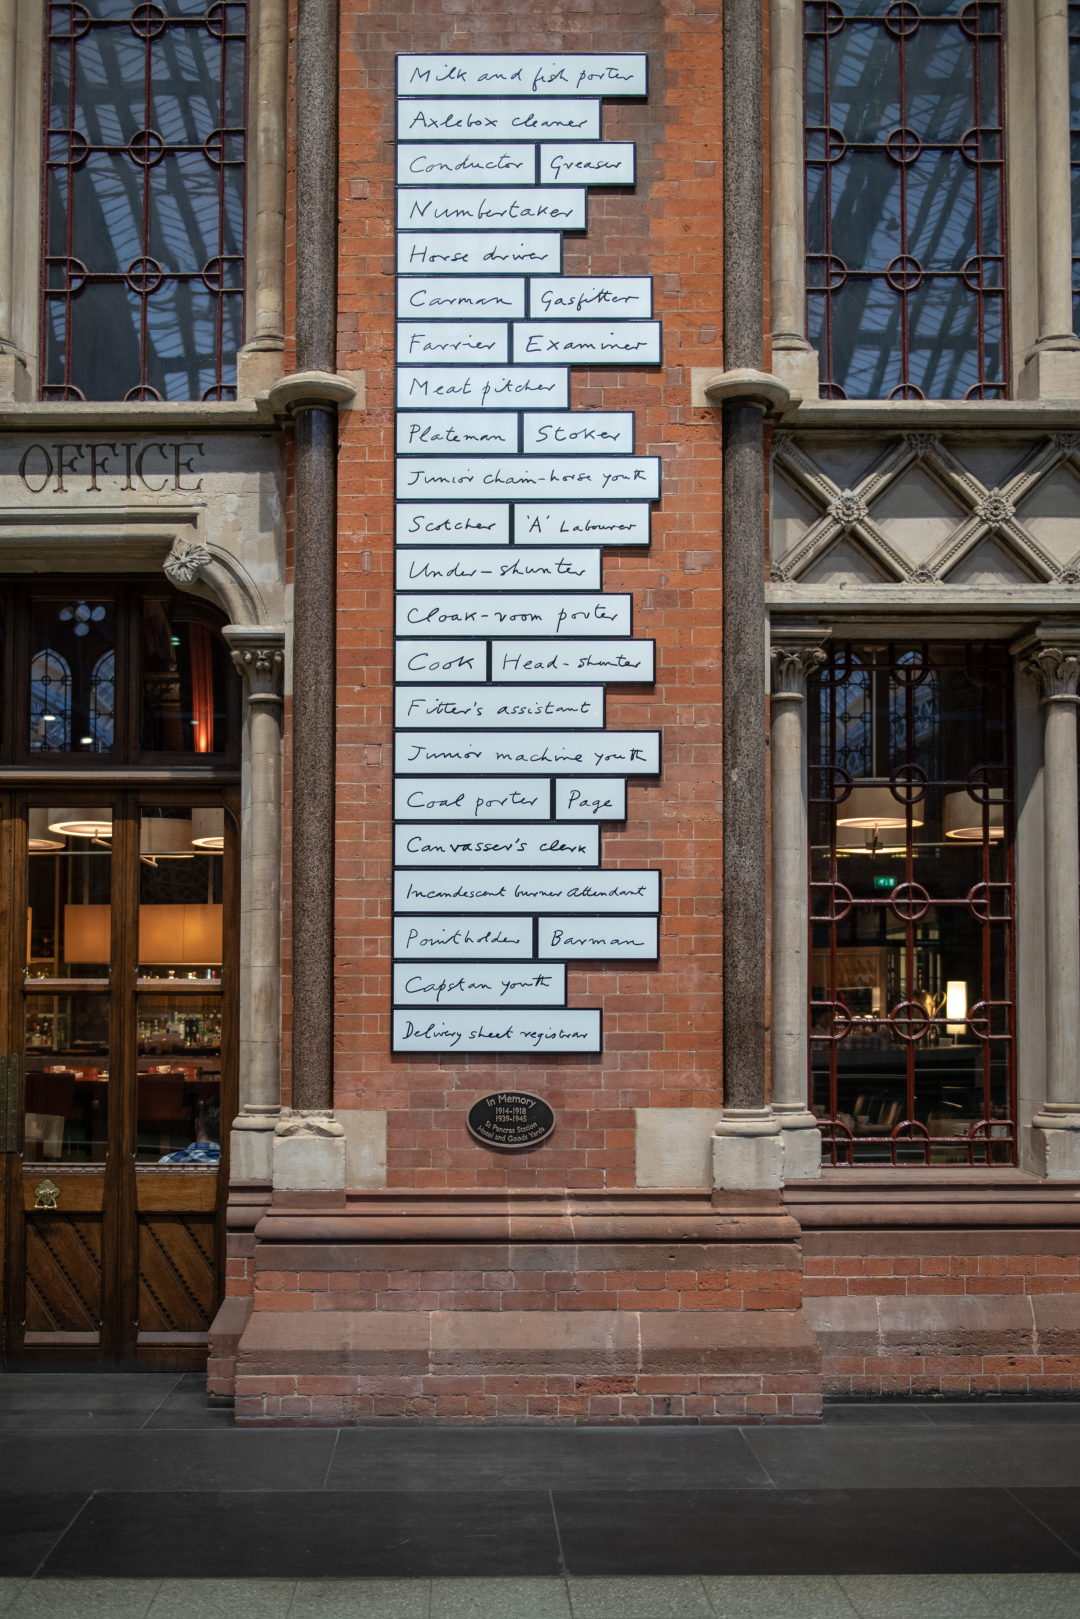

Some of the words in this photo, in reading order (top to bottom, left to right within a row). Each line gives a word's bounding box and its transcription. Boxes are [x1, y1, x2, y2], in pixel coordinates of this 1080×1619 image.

[410, 65, 467, 83] Milk
[477, 68, 522, 81] and
[532, 62, 568, 92] fish
[576, 68, 634, 88] porter
[409, 111, 498, 128] Axlebox
[512, 114, 587, 128] cleaner
[410, 154, 523, 173] Conductor
[410, 199, 573, 219] Numbertaker
[410, 245, 468, 263] Horse
[483, 243, 548, 260] driver
[410, 290, 512, 306] Carman
[541, 288, 639, 312] Gasfitter
[410, 334, 495, 353] Farrier
[526, 333, 647, 352] Examiner
[410, 378, 471, 395] Meat
[481, 377, 555, 405] pitcher
[409, 424, 505, 443] Plateman
[536, 425, 620, 442] Stoker
[18, 442, 205, 493] OFFICE
[408, 469, 474, 485] Junior
[602, 469, 646, 488] youth
[409, 516, 496, 532] Scotcher
[560, 520, 636, 532] Labourer
[407, 608, 542, 623] Cloak-room
[557, 604, 618, 632] porter
[408, 653, 474, 670] Cook
[408, 699, 483, 716] Fitter's
[497, 701, 590, 714] assistant
[408, 744, 482, 761] Junior
[496, 747, 582, 762] machine
[594, 748, 646, 766] youth
[407, 792, 465, 808] Coal
[475, 791, 538, 816] porter
[568, 790, 612, 814] Page
[407, 836, 527, 852] Canvasser's
[540, 840, 586, 853] clerk
[407, 884, 506, 899] Incandescent
[515, 885, 562, 897] burner
[567, 886, 646, 897] attendant
[407, 929, 520, 948] Pointholder
[551, 930, 644, 946] Barman
[405, 976, 491, 1002] Capstan
[500, 974, 552, 996] youth
[402, 1021, 461, 1047] Delivery
[469, 1026, 513, 1039] sheet
[520, 1028, 587, 1046] registrar
[486, 1098, 496, 1107] In
[498, 1094, 536, 1108] Memory
[477, 1125, 494, 1138] Hotel
[507, 1134, 528, 1142] Goods
[528, 1126, 545, 1138] Yards
[485, 1120, 491, 1128] St
[492, 1124, 515, 1133] Pancras
[517, 1122, 538, 1133] Station
